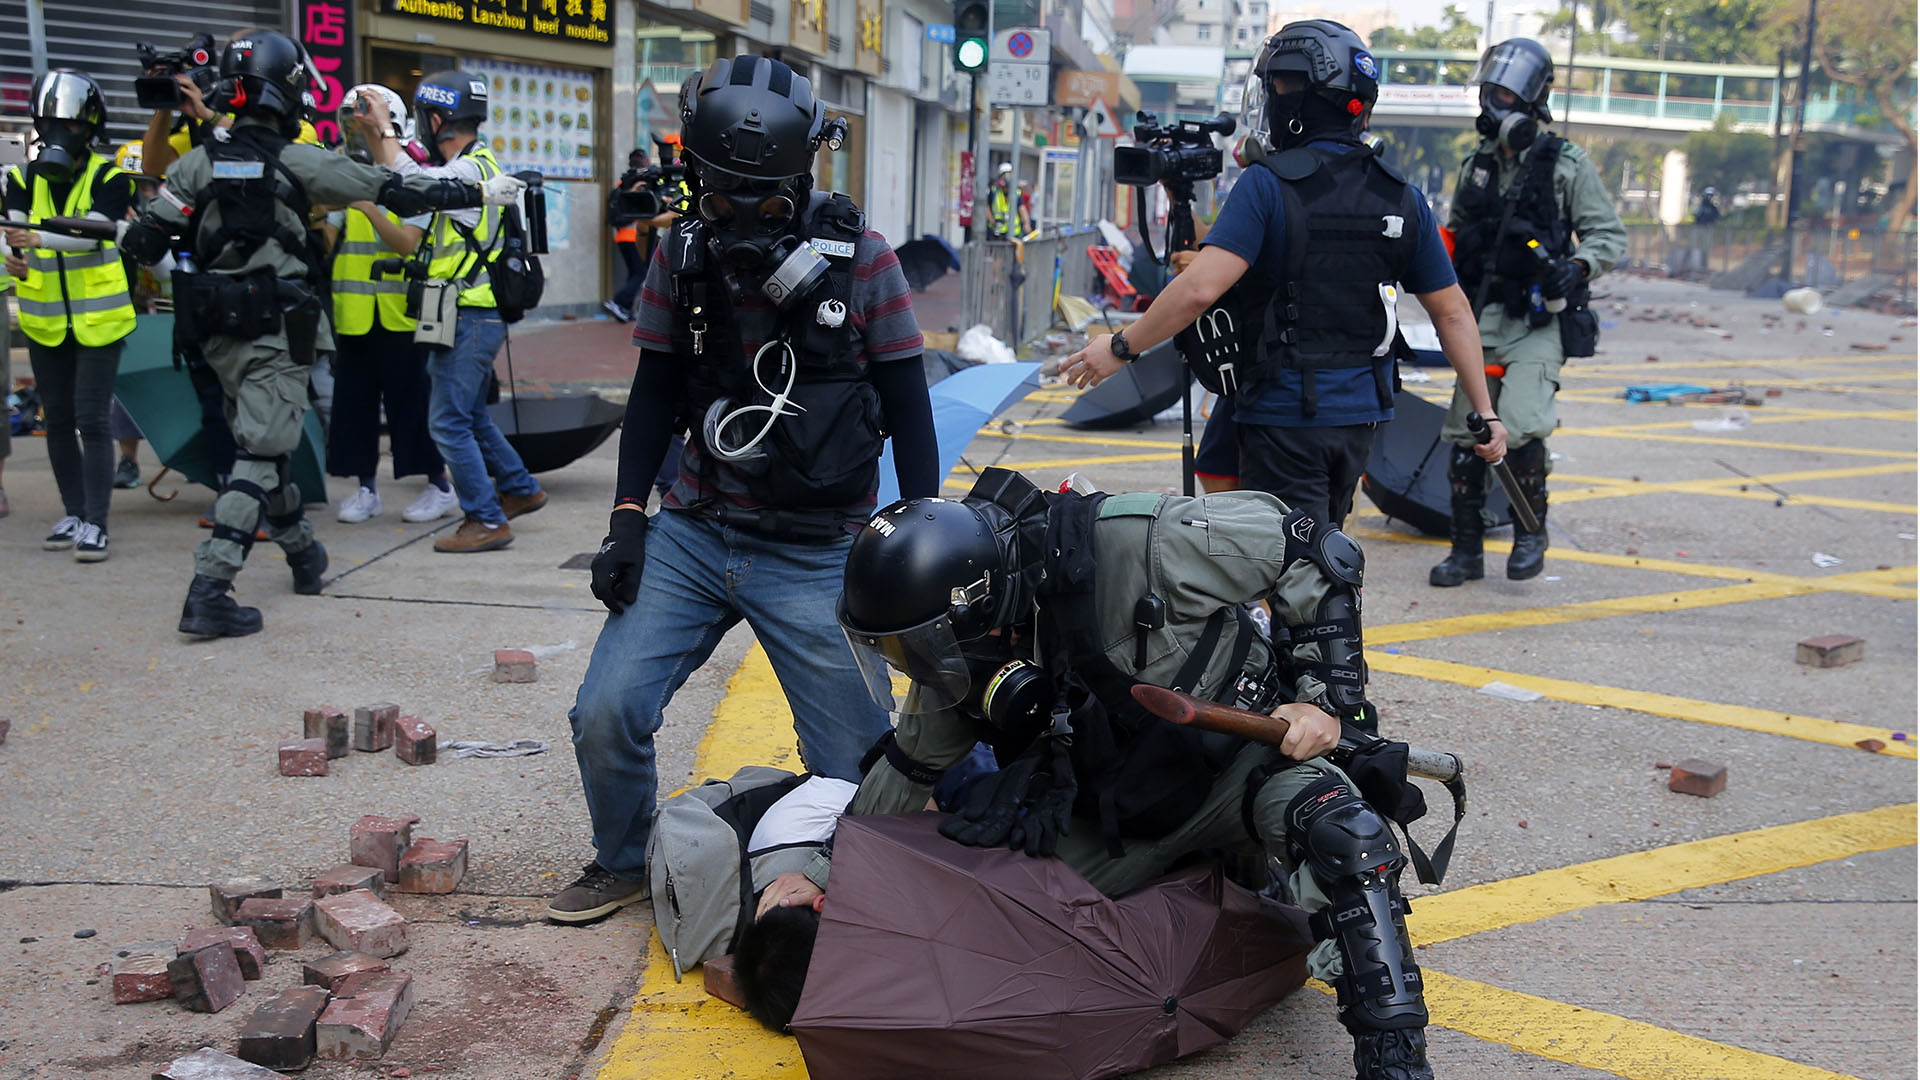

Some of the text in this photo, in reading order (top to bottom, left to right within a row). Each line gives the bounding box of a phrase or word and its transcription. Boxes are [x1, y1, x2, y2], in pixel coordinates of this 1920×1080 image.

[304, 3, 346, 46] 店
[396, 0, 609, 42] Authentic Lanzhou beef noodles
[419, 86, 455, 105] PRESS
[812, 241, 852, 255] POLICE
[869, 516, 897, 538] MAR
